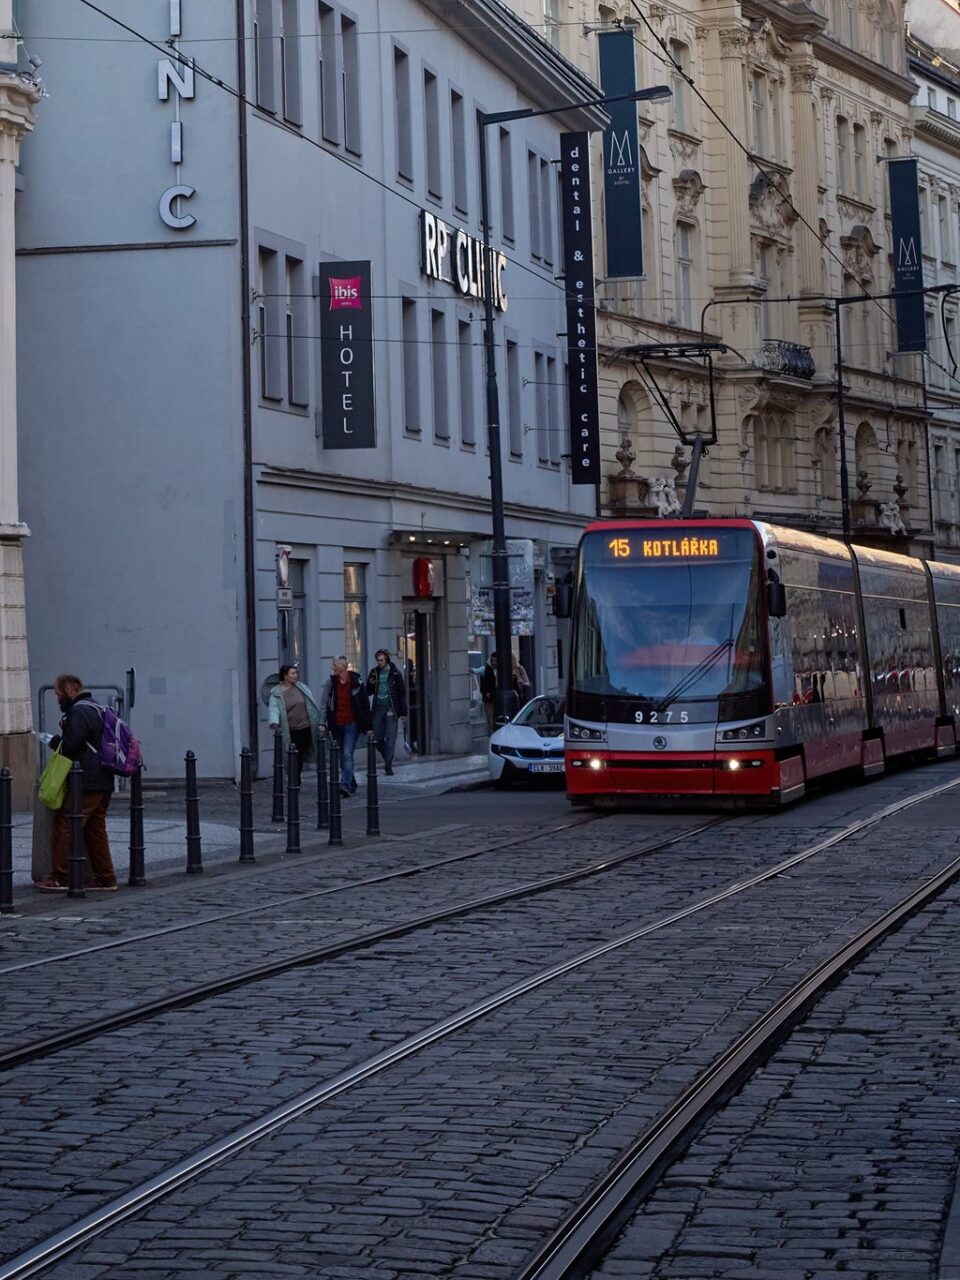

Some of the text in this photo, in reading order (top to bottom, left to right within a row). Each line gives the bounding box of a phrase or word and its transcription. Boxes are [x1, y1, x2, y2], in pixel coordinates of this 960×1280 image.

[423, 209, 448, 281] RP
[334, 285, 358, 300] ibis
[570, 146, 581, 232] dental
[580, 413, 591, 468] care
[339, 324, 354, 435] HOTEL
[608, 537, 718, 558] 15 KOTLÁŘKA
[634, 710, 689, 724] 9275
